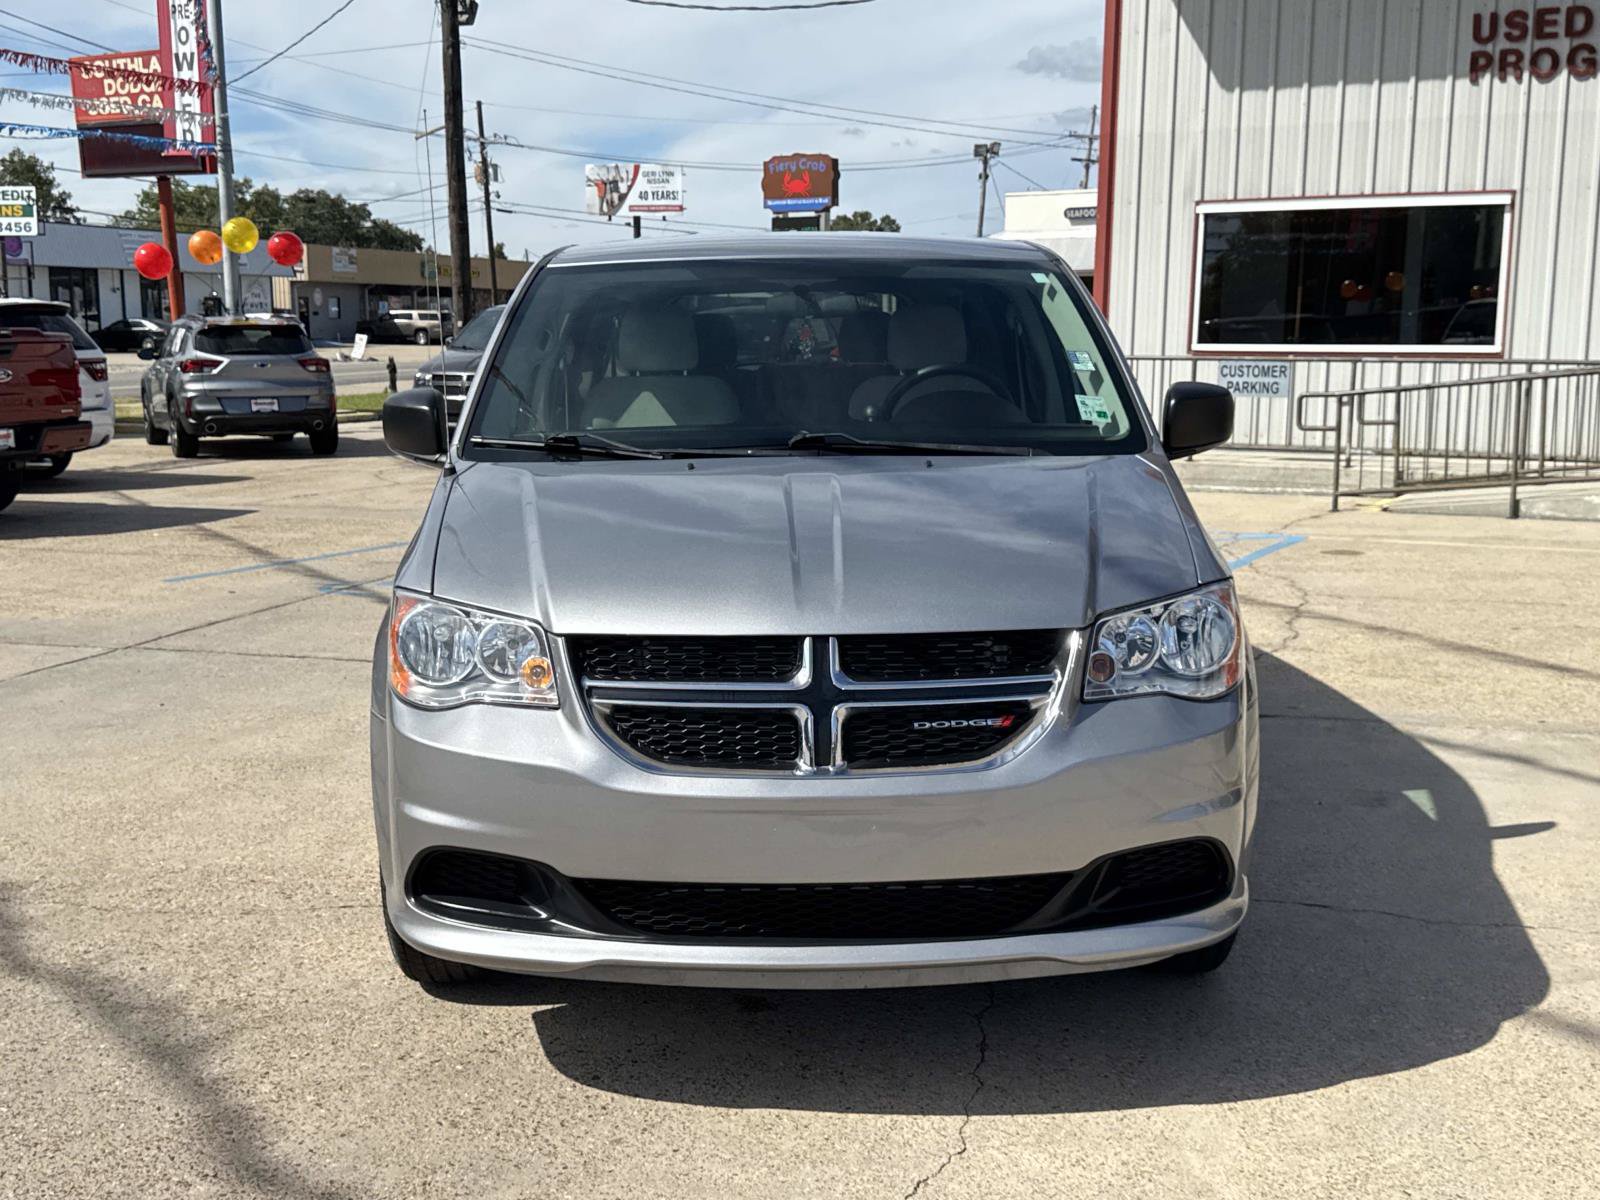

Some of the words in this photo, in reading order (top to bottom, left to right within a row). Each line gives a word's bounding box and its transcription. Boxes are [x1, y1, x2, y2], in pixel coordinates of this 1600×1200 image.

[1472, 5, 1594, 45] USED
[1469, 43, 1597, 86] PROG
[799, 158, 826, 172] Crab
[0, 189, 33, 201] EDIT
[638, 190, 649, 201] 40
[651, 190, 679, 201] YEARS!
[0, 205, 23, 217] NS
[1220, 364, 1287, 378] CUSTOMER
[1226, 381, 1280, 394] PARKING
[913, 717, 1003, 730] DODGE
